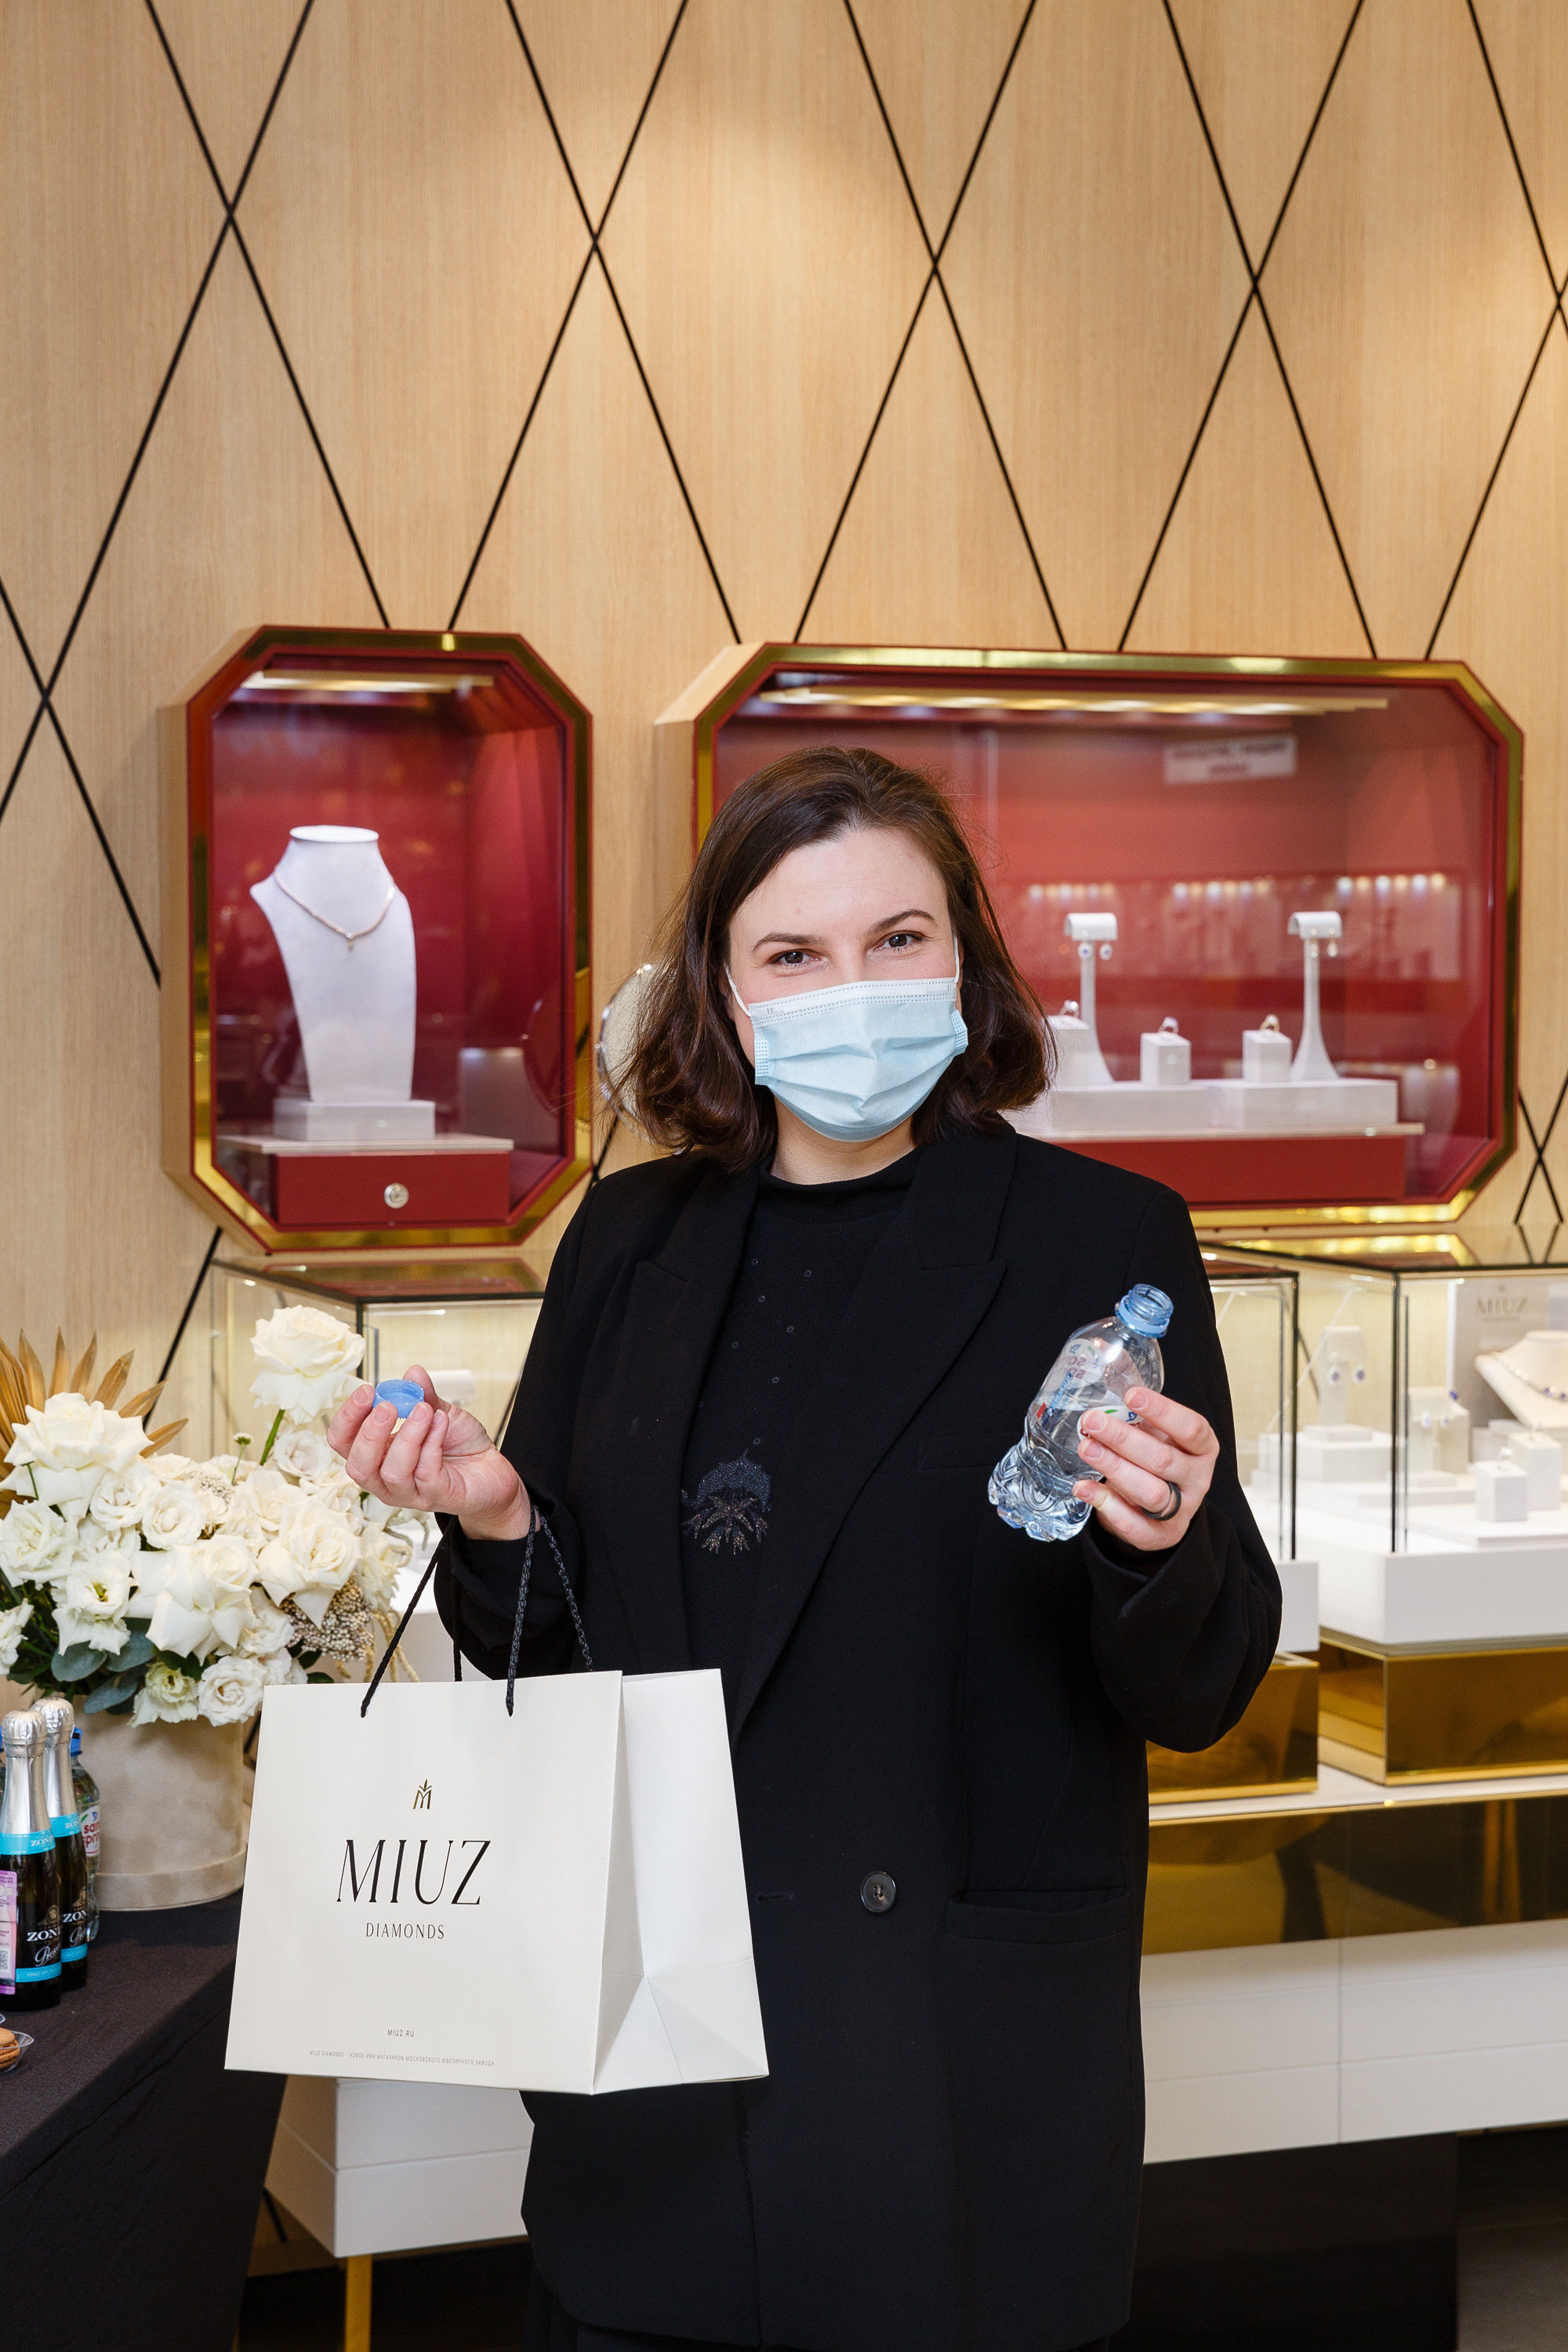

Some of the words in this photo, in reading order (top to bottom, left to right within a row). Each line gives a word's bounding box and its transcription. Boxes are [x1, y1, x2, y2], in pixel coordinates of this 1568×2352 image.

[336, 1839, 491, 1905] MIUZ
[366, 1922, 445, 1940] DIAMONDS
[387, 2029, 415, 2038] MIUZ.RU
